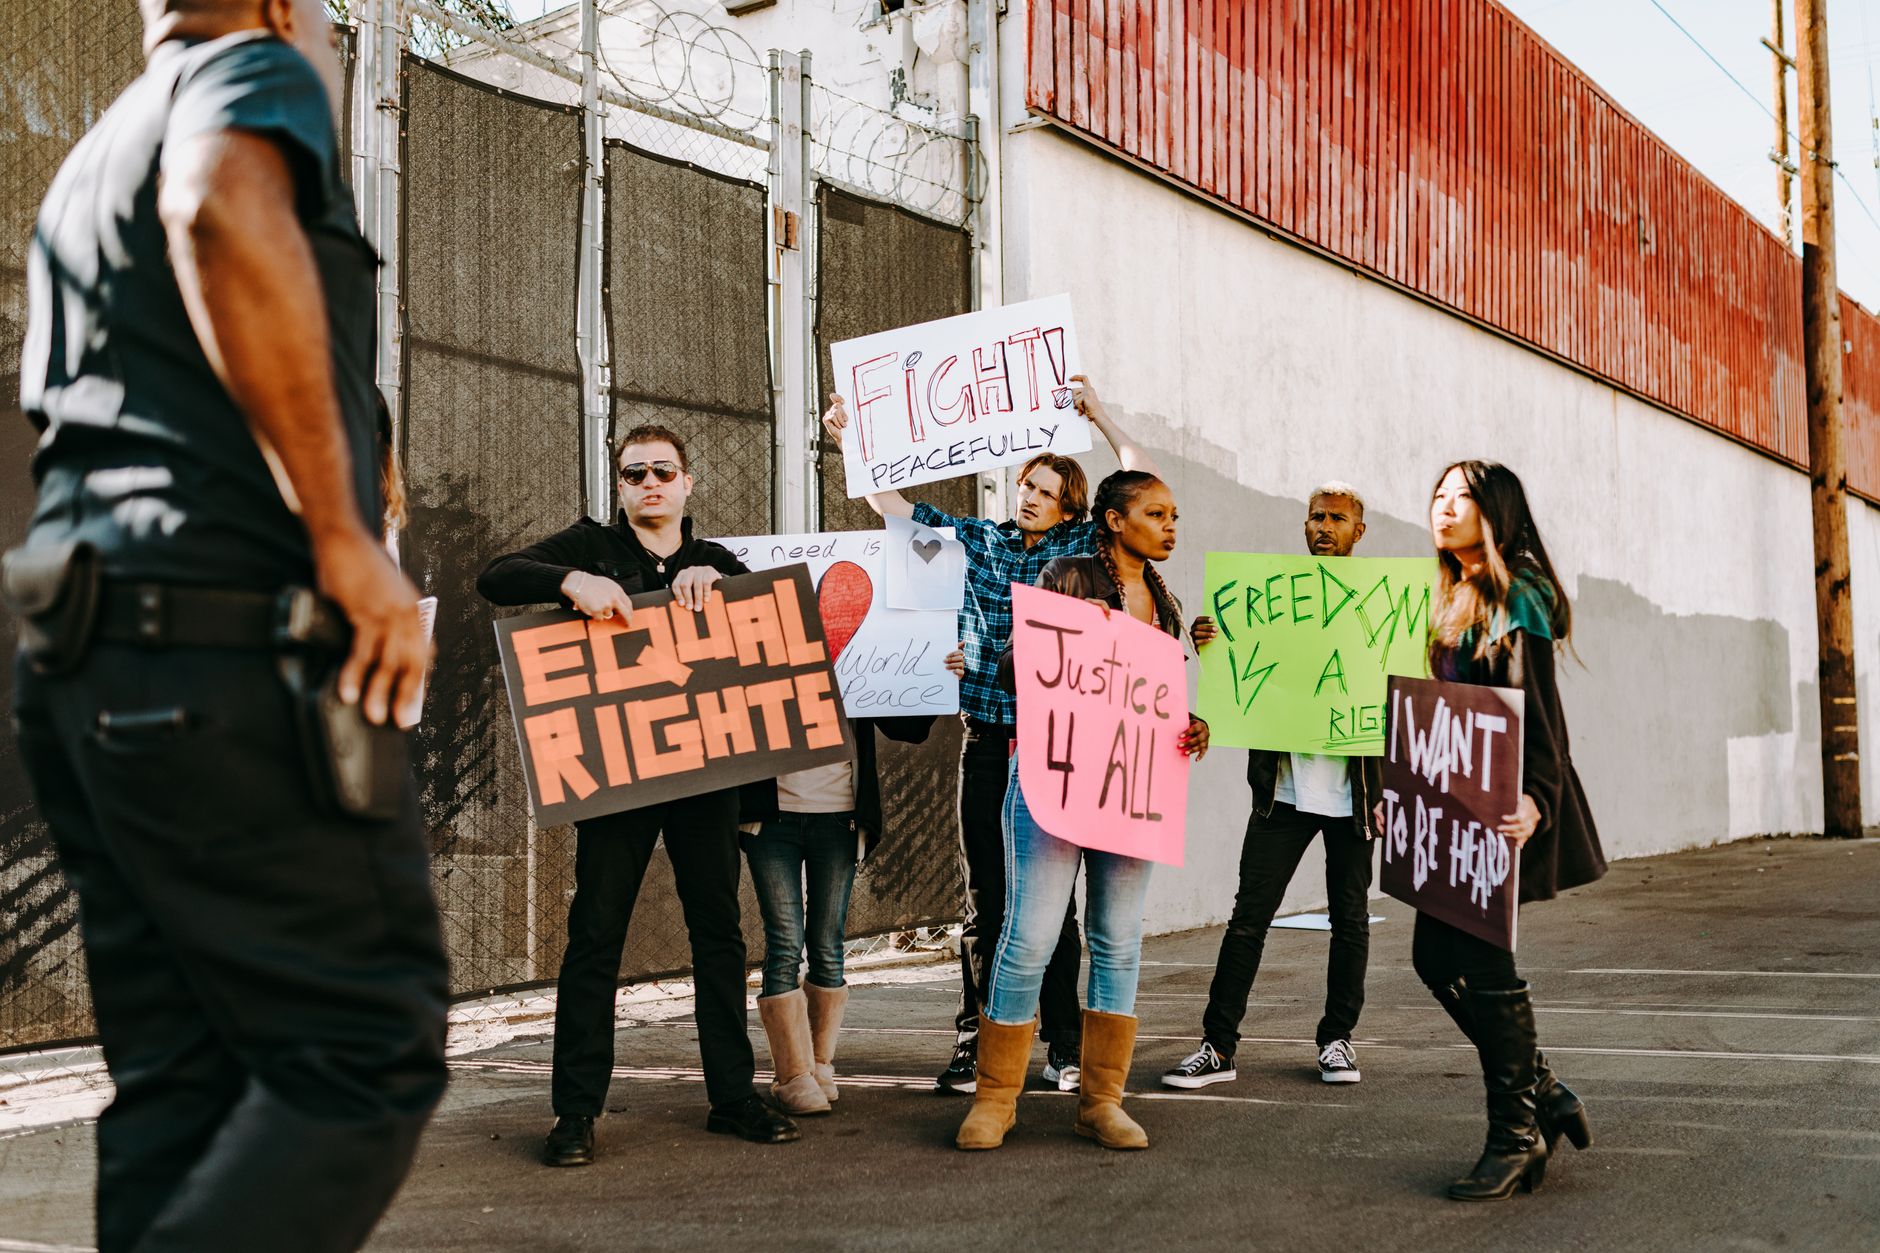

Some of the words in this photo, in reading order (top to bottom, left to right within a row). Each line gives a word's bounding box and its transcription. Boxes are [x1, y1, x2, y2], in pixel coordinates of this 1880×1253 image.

[871, 424, 1060, 488] PEACEFULLY
[771, 538, 837, 562] need
[863, 538, 880, 556] is
[511, 578, 826, 707] EQUAL
[836, 638, 934, 676] World
[1213, 562, 1430, 672] FREEDOM
[842, 675, 950, 708] Peace
[1025, 619, 1170, 720] Justice
[1228, 641, 1280, 716] IS
[1314, 648, 1348, 698] A
[524, 670, 845, 806] RIGHTS
[1047, 709, 1074, 810] 4
[1098, 719, 1163, 822] ALL
[1390, 689, 1400, 763] I
[1405, 696, 1507, 793] WANT
[1382, 788, 1408, 864] TO
[1413, 794, 1443, 892] BE
[1450, 819, 1510, 912] HEARD
